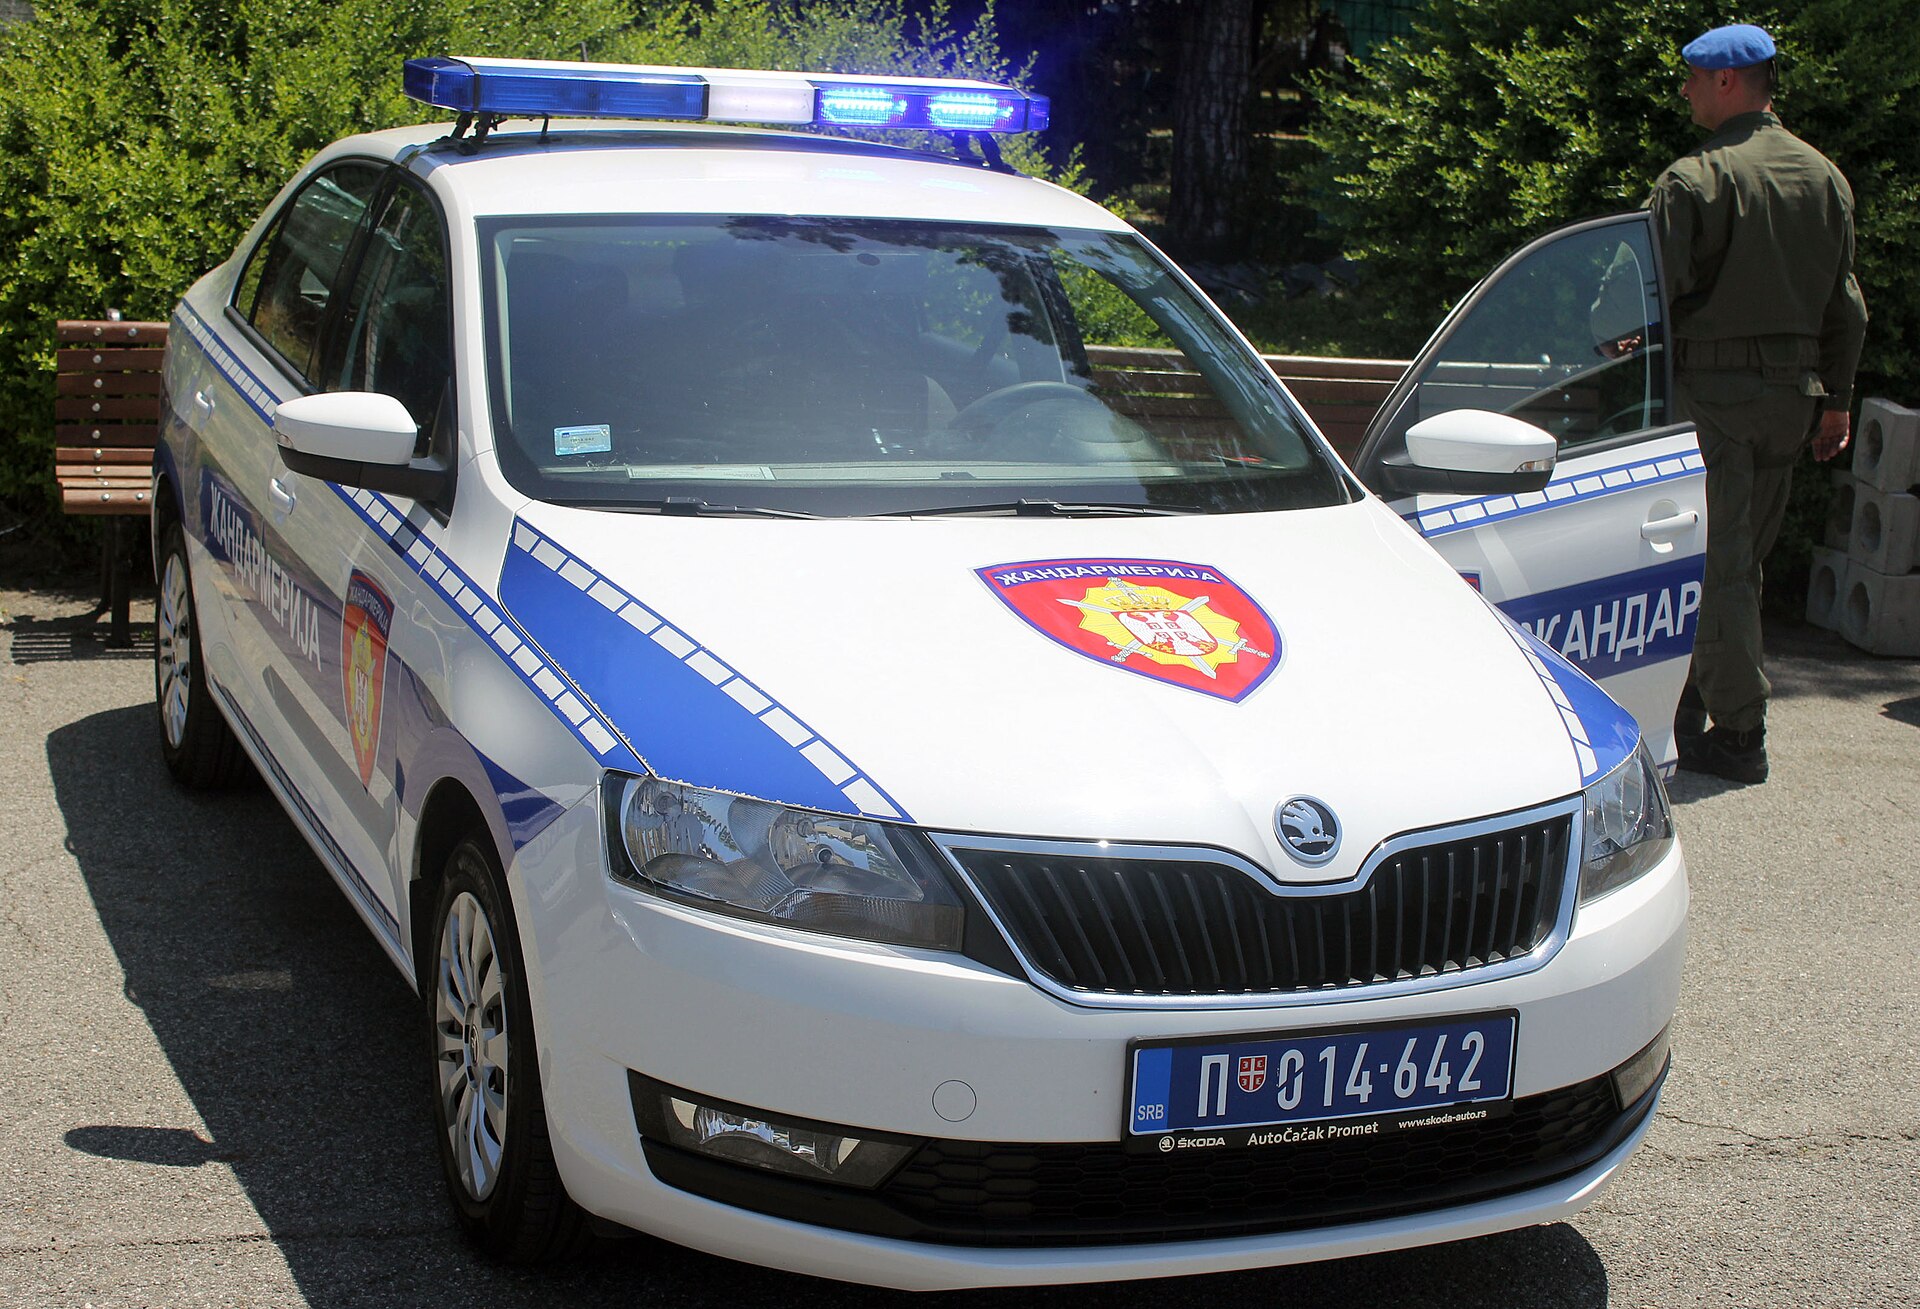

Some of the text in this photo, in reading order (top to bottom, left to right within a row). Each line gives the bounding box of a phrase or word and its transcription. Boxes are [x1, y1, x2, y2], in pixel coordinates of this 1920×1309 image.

[210, 481, 322, 673] ЖАНДАРМЕРИЈА
[997, 564, 1222, 588] ЖАНДАРМЕРИЈА
[1197, 1053, 1229, 1118] П
[1137, 1104, 1165, 1121] SRB
[1398, 1110, 1487, 1129] www.skoda-auto.rs
[1177, 1137, 1226, 1149] ŠKODA
[1247, 1121, 1379, 1146] AutoČačak Promet
